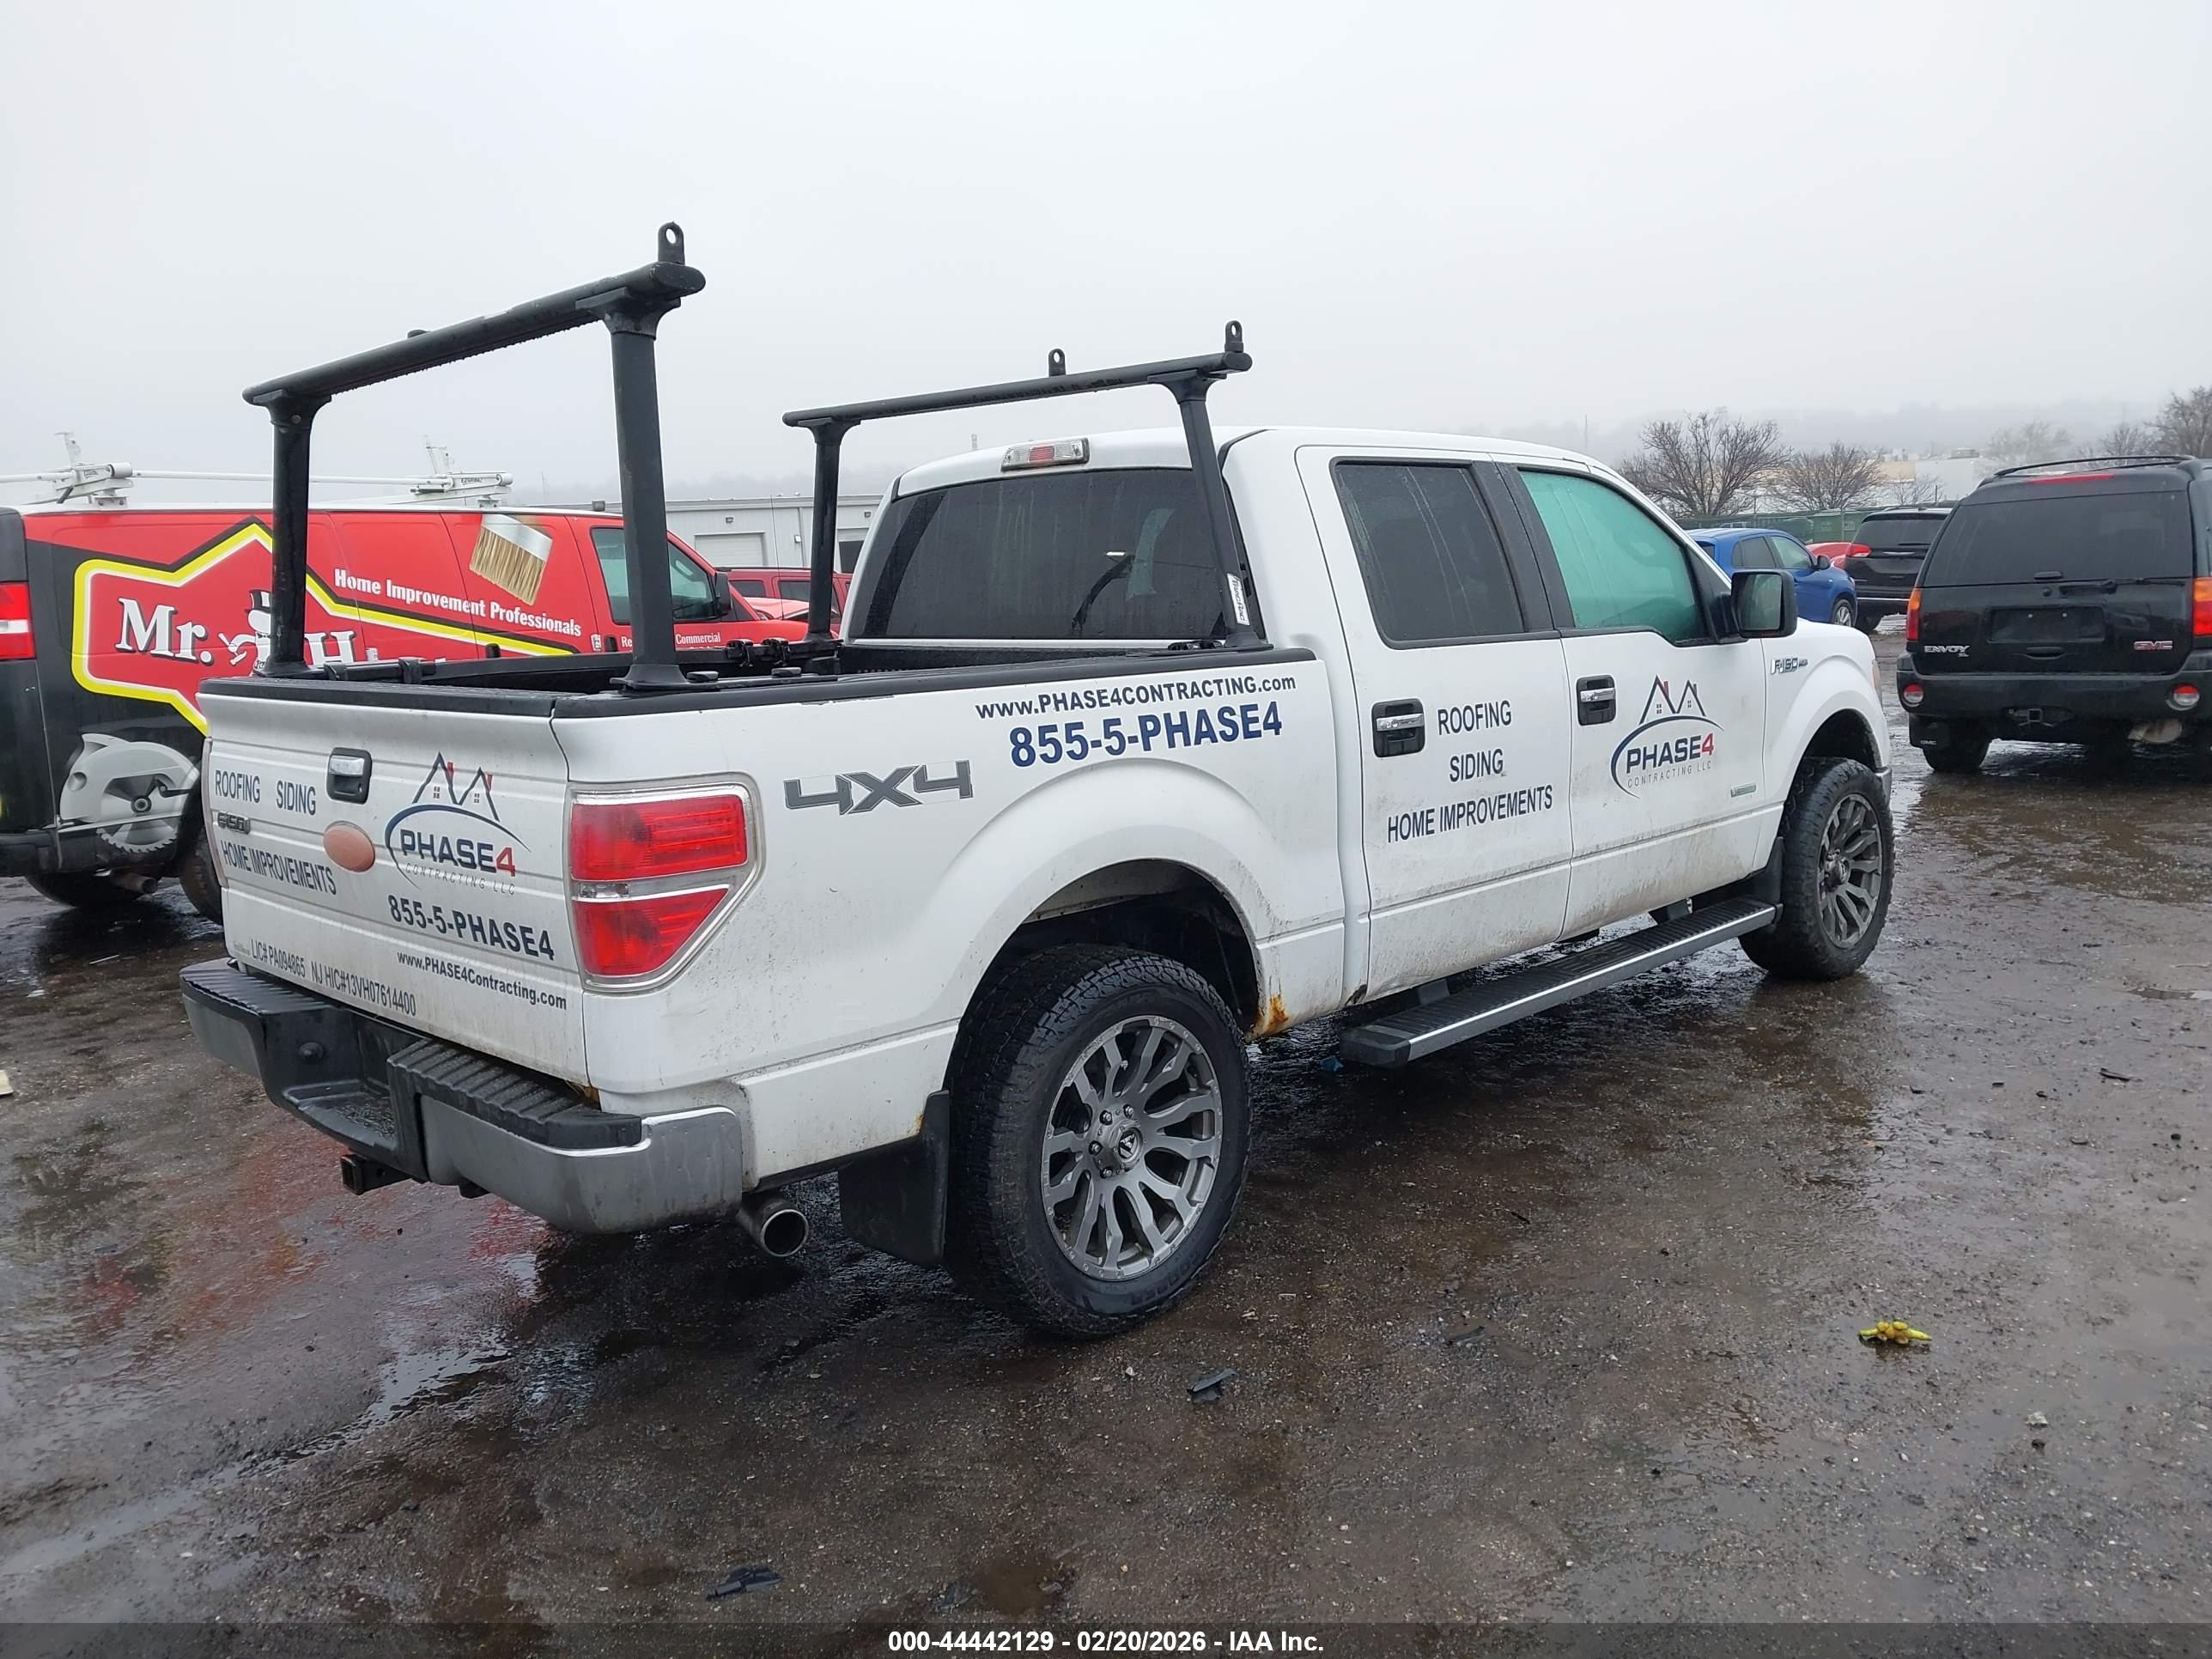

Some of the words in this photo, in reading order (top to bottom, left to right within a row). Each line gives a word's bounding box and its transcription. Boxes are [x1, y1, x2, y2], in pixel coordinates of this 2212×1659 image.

[334, 568, 381, 595] Home
[386, 578, 486, 617] Improvement
[489, 602, 582, 637] Professionals
[114, 596, 213, 665] Mr.
[676, 632, 721, 645] Commercial
[1923, 645, 1971, 653] ENVOY
[2134, 641, 2173, 651] GMC
[975, 675, 1297, 720] www.PHASE4CONTRACTING.com
[1437, 700, 1512, 736] ROOFING
[1009, 701, 1283, 769] 855-5-PHASE4
[1626, 732, 1715, 775] PHASE4
[783, 760, 974, 816] 4X4
[1449, 748, 1504, 783] SIDING
[1627, 764, 1692, 788] CONTRACTING
[1697, 760, 1712, 772] LLC
[215, 769, 260, 804] ROOFING
[276, 780, 317, 817] SIDING
[1388, 806, 1435, 844] HOME
[1439, 784, 1553, 834] IMPROVEMENTS
[221, 839, 252, 872] HOME
[252, 849, 337, 896] IMPROVEMENTS
[400, 829, 516, 878] PHASE4
[405, 862, 486, 890] CONTRACTING
[493, 880, 515, 896] LLC
[387, 894, 556, 961] 855-5-PHASE4
[251, 939, 268, 963] LIC#
[310, 961, 323, 984] NJ
[397, 951, 568, 1011] www.PHASE4Contracting.com
